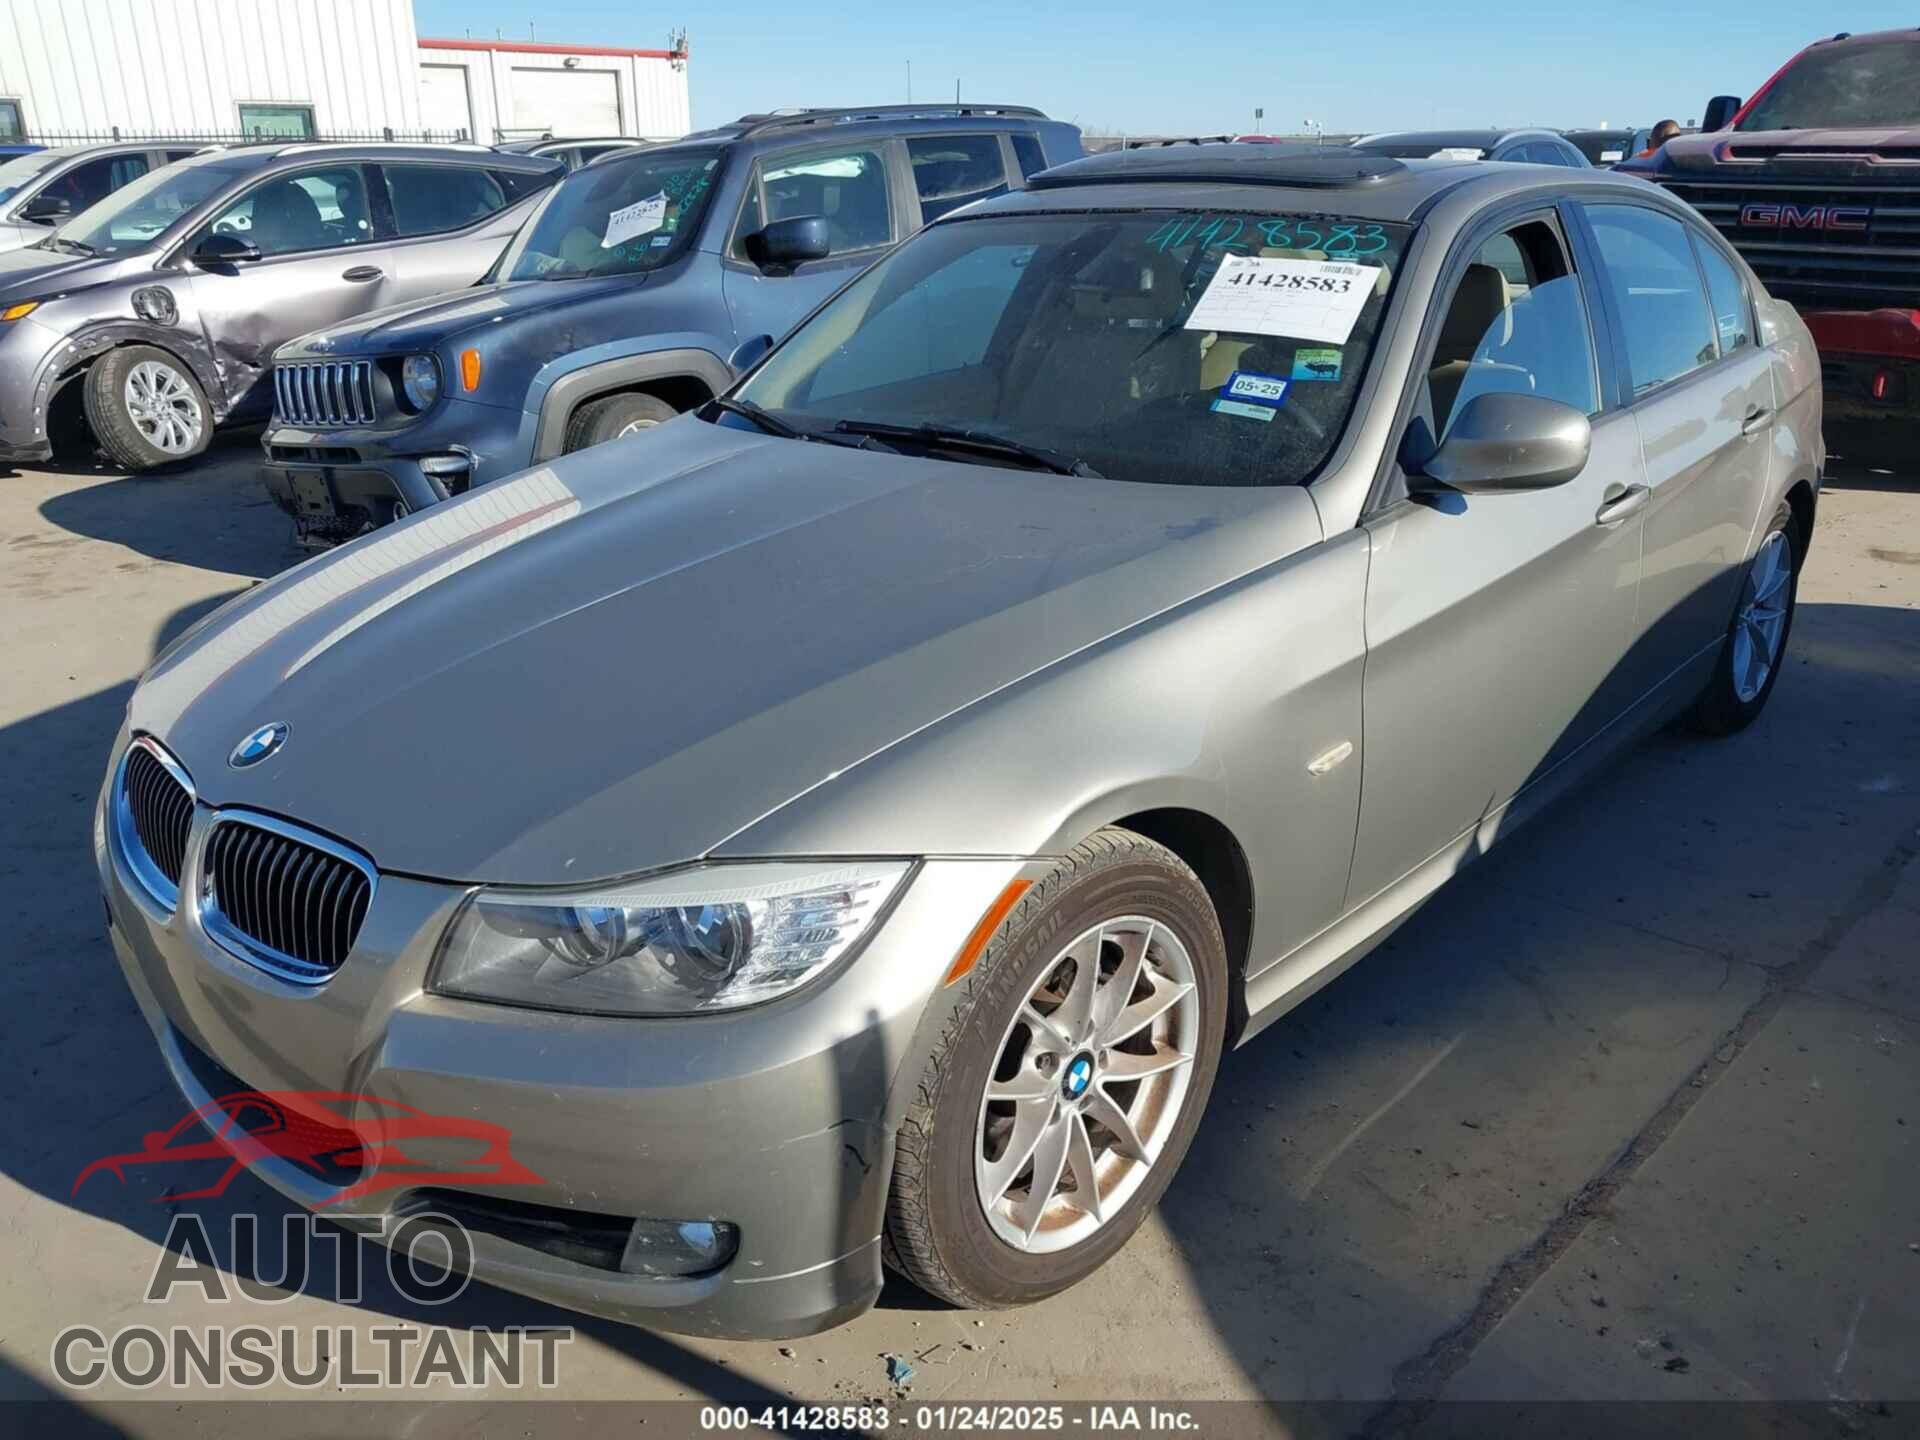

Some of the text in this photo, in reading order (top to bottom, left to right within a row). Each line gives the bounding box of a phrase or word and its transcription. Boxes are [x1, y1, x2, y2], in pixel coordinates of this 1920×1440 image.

[1741, 204, 1870, 230] GMC
[1146, 217, 1389, 253] 41428583
[1228, 272, 1351, 294] 41428583
